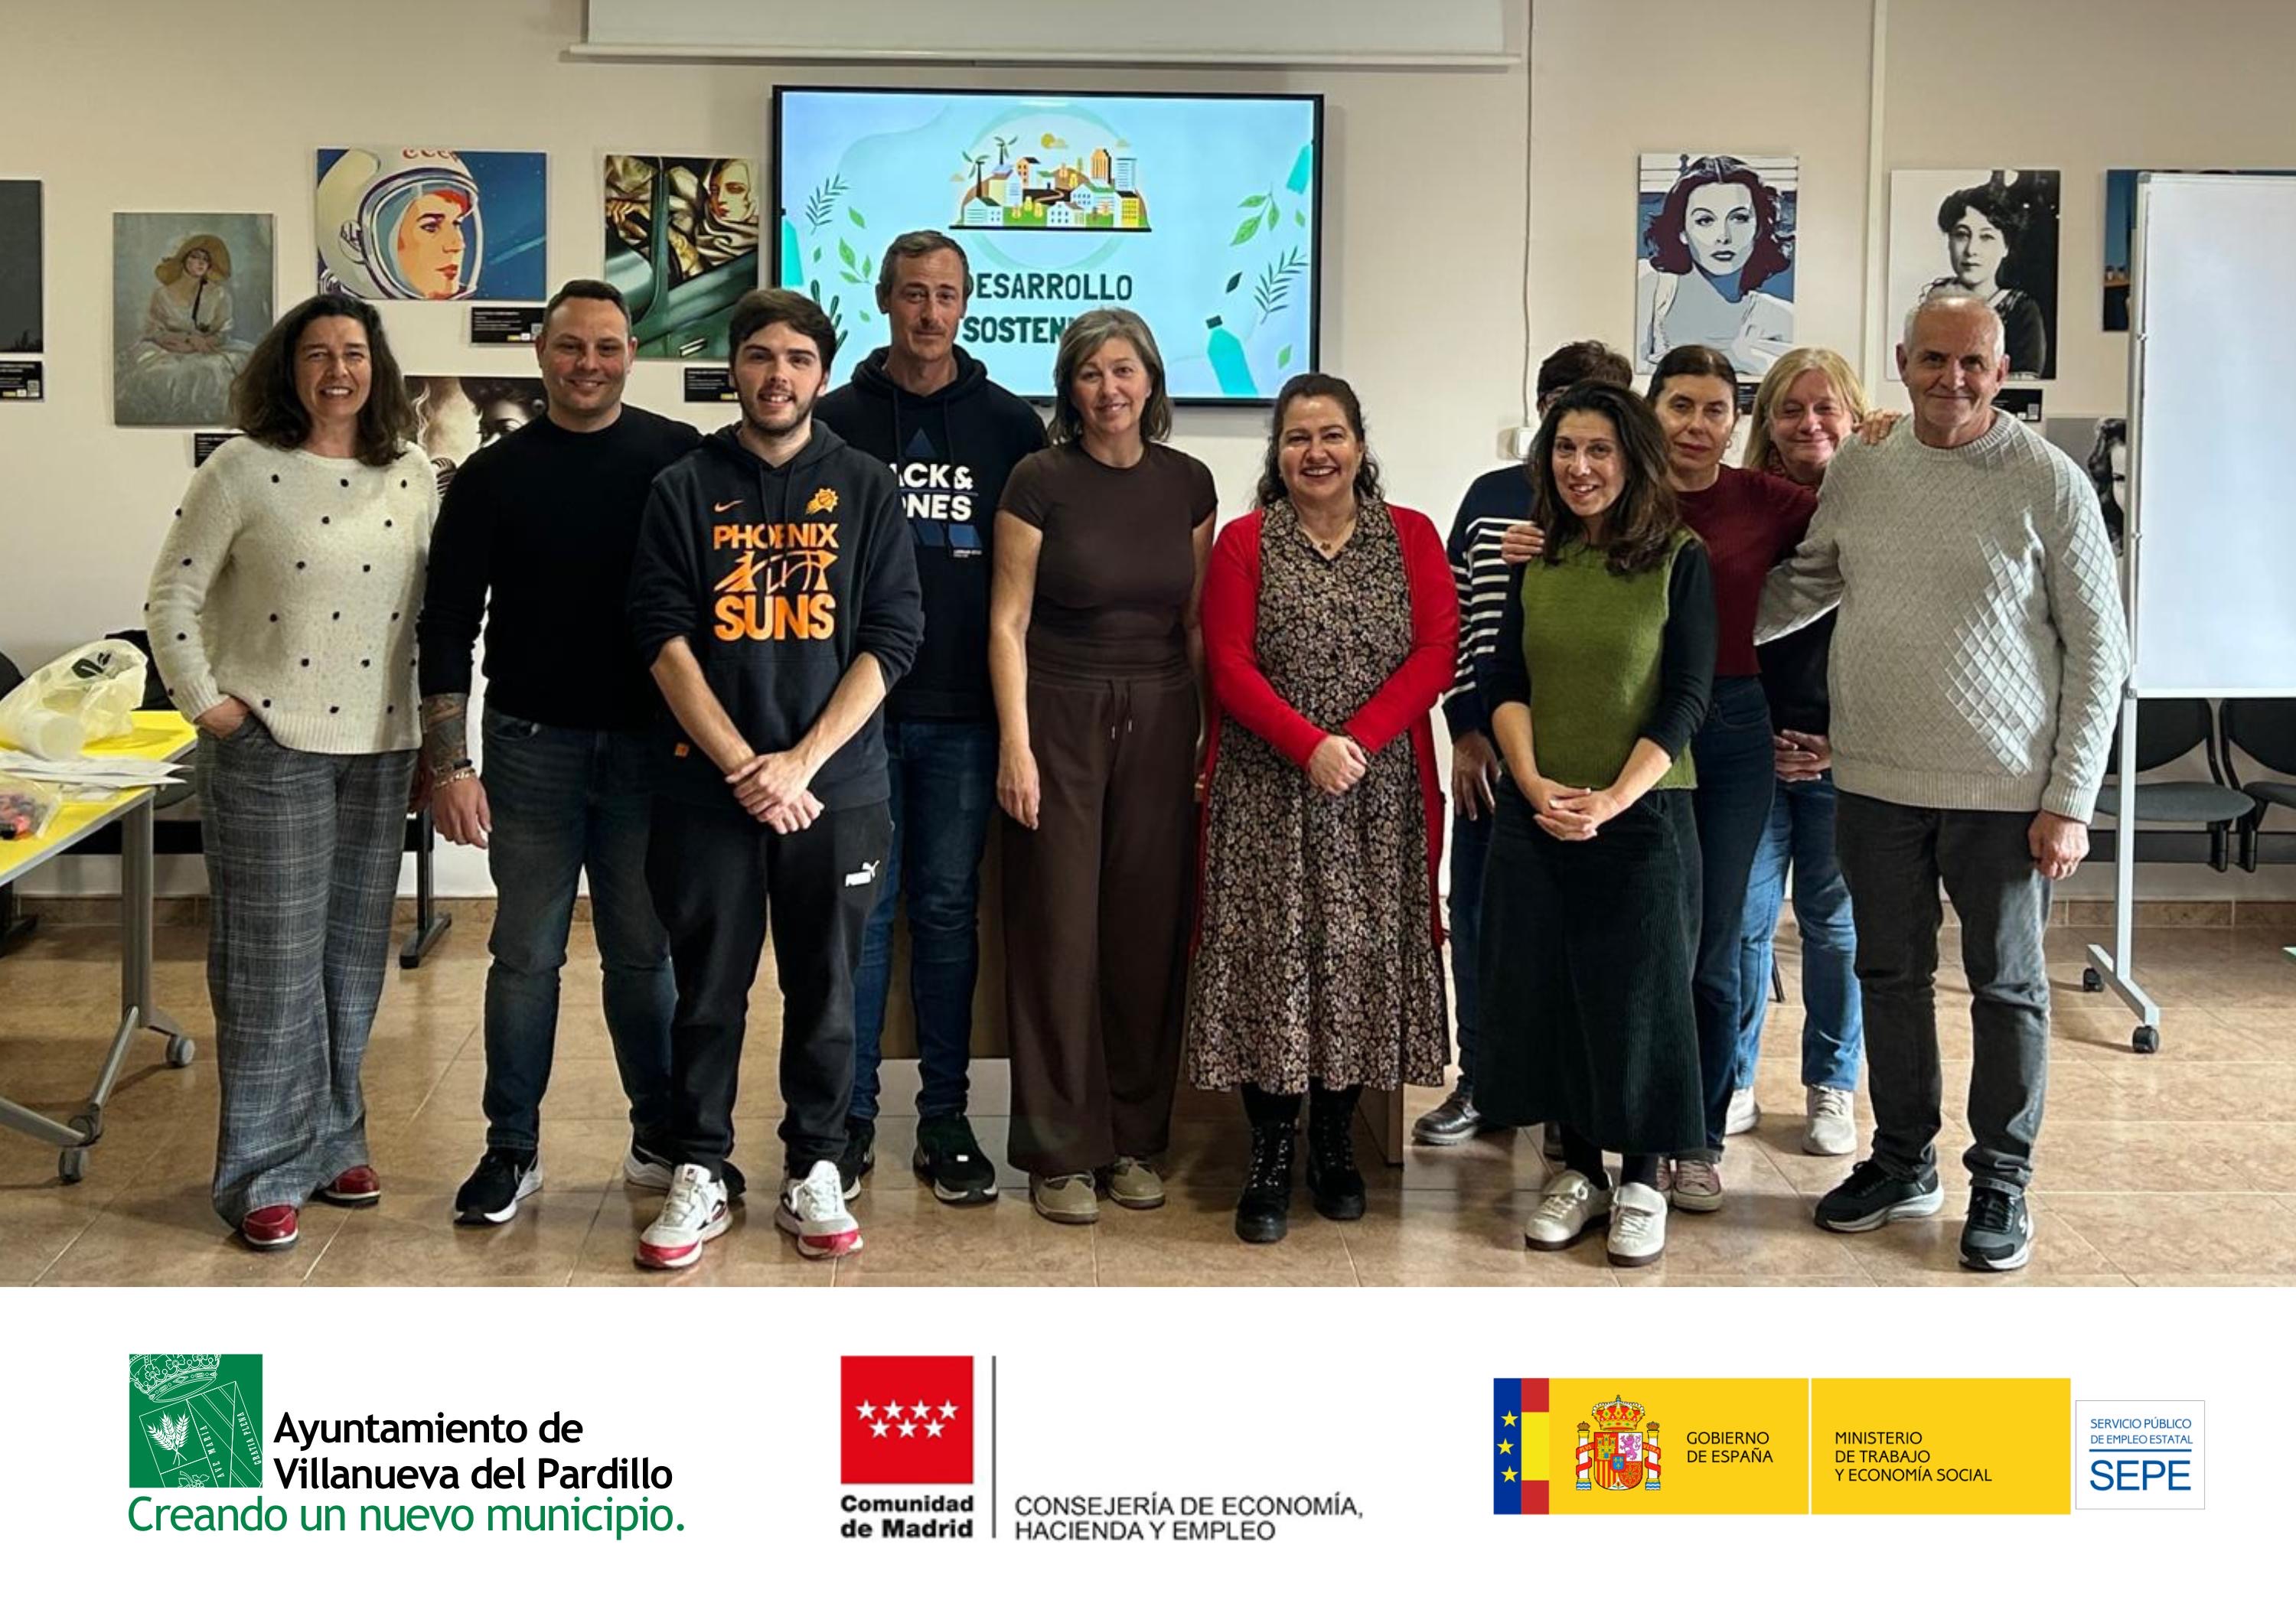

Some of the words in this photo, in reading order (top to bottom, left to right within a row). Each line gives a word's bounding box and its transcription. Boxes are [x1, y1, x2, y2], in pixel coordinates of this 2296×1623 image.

[968, 273, 1133, 300] ESARROLLO
[962, 316, 1073, 344] SOSTEN
[902, 493, 972, 521] NES
[713, 523, 840, 550] PHOENIX
[713, 593, 837, 641] SUNS
